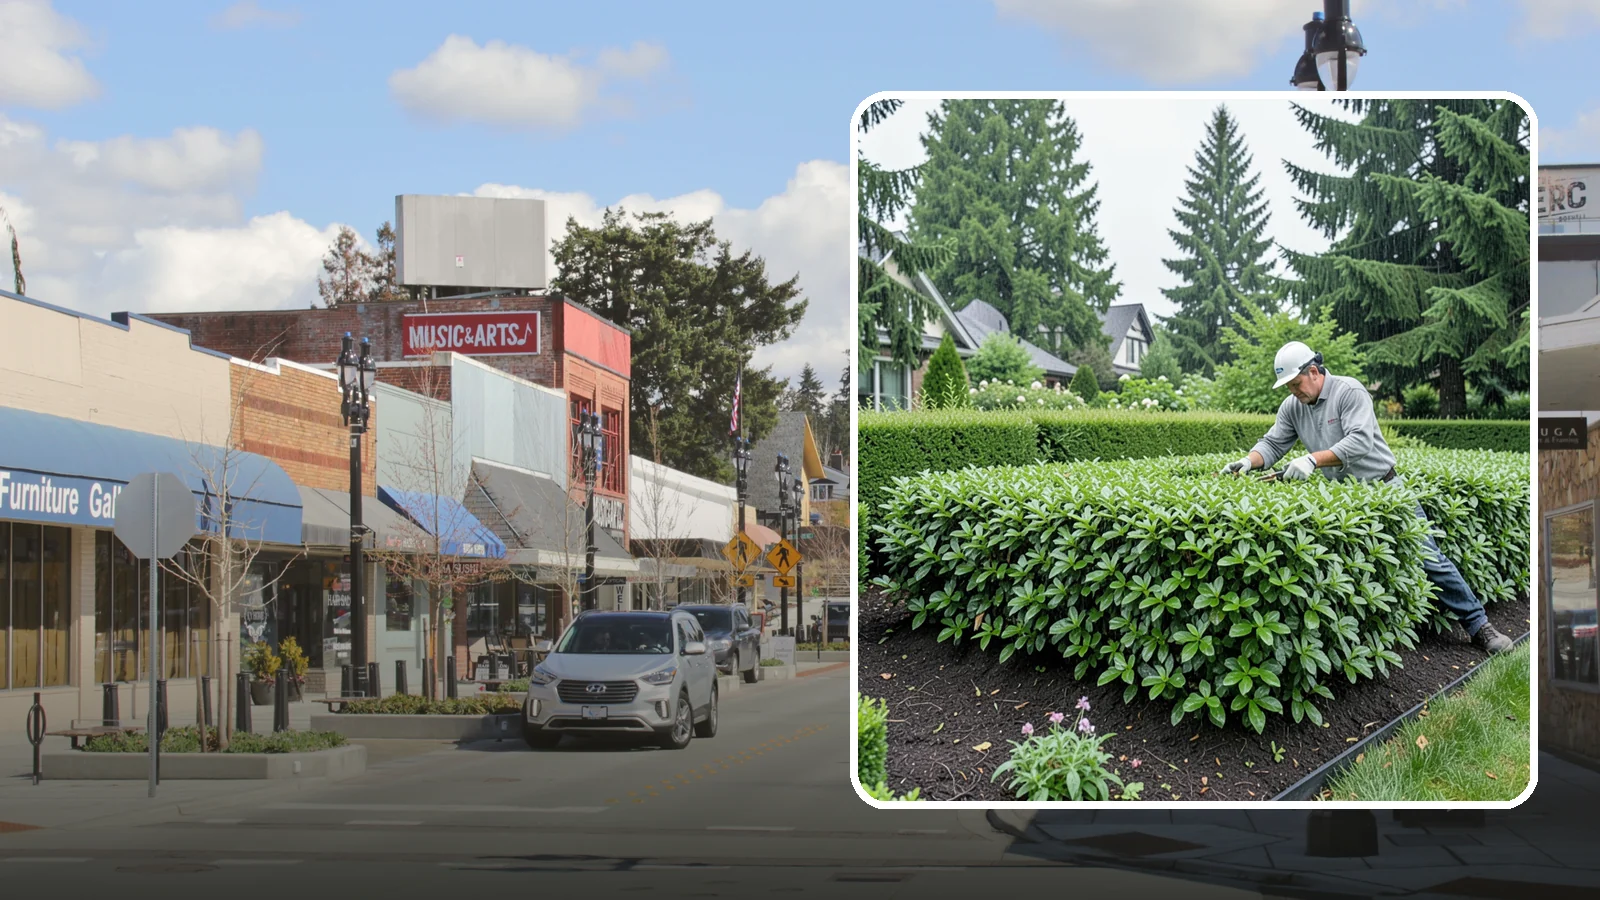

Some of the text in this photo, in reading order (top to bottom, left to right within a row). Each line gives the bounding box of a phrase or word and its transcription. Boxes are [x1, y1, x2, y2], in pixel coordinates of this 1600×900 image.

[409, 323, 519, 349] MUSIC&ARTS
[1540, 427, 1577, 437] UGA
[0, 471, 79, 515] Furniture
